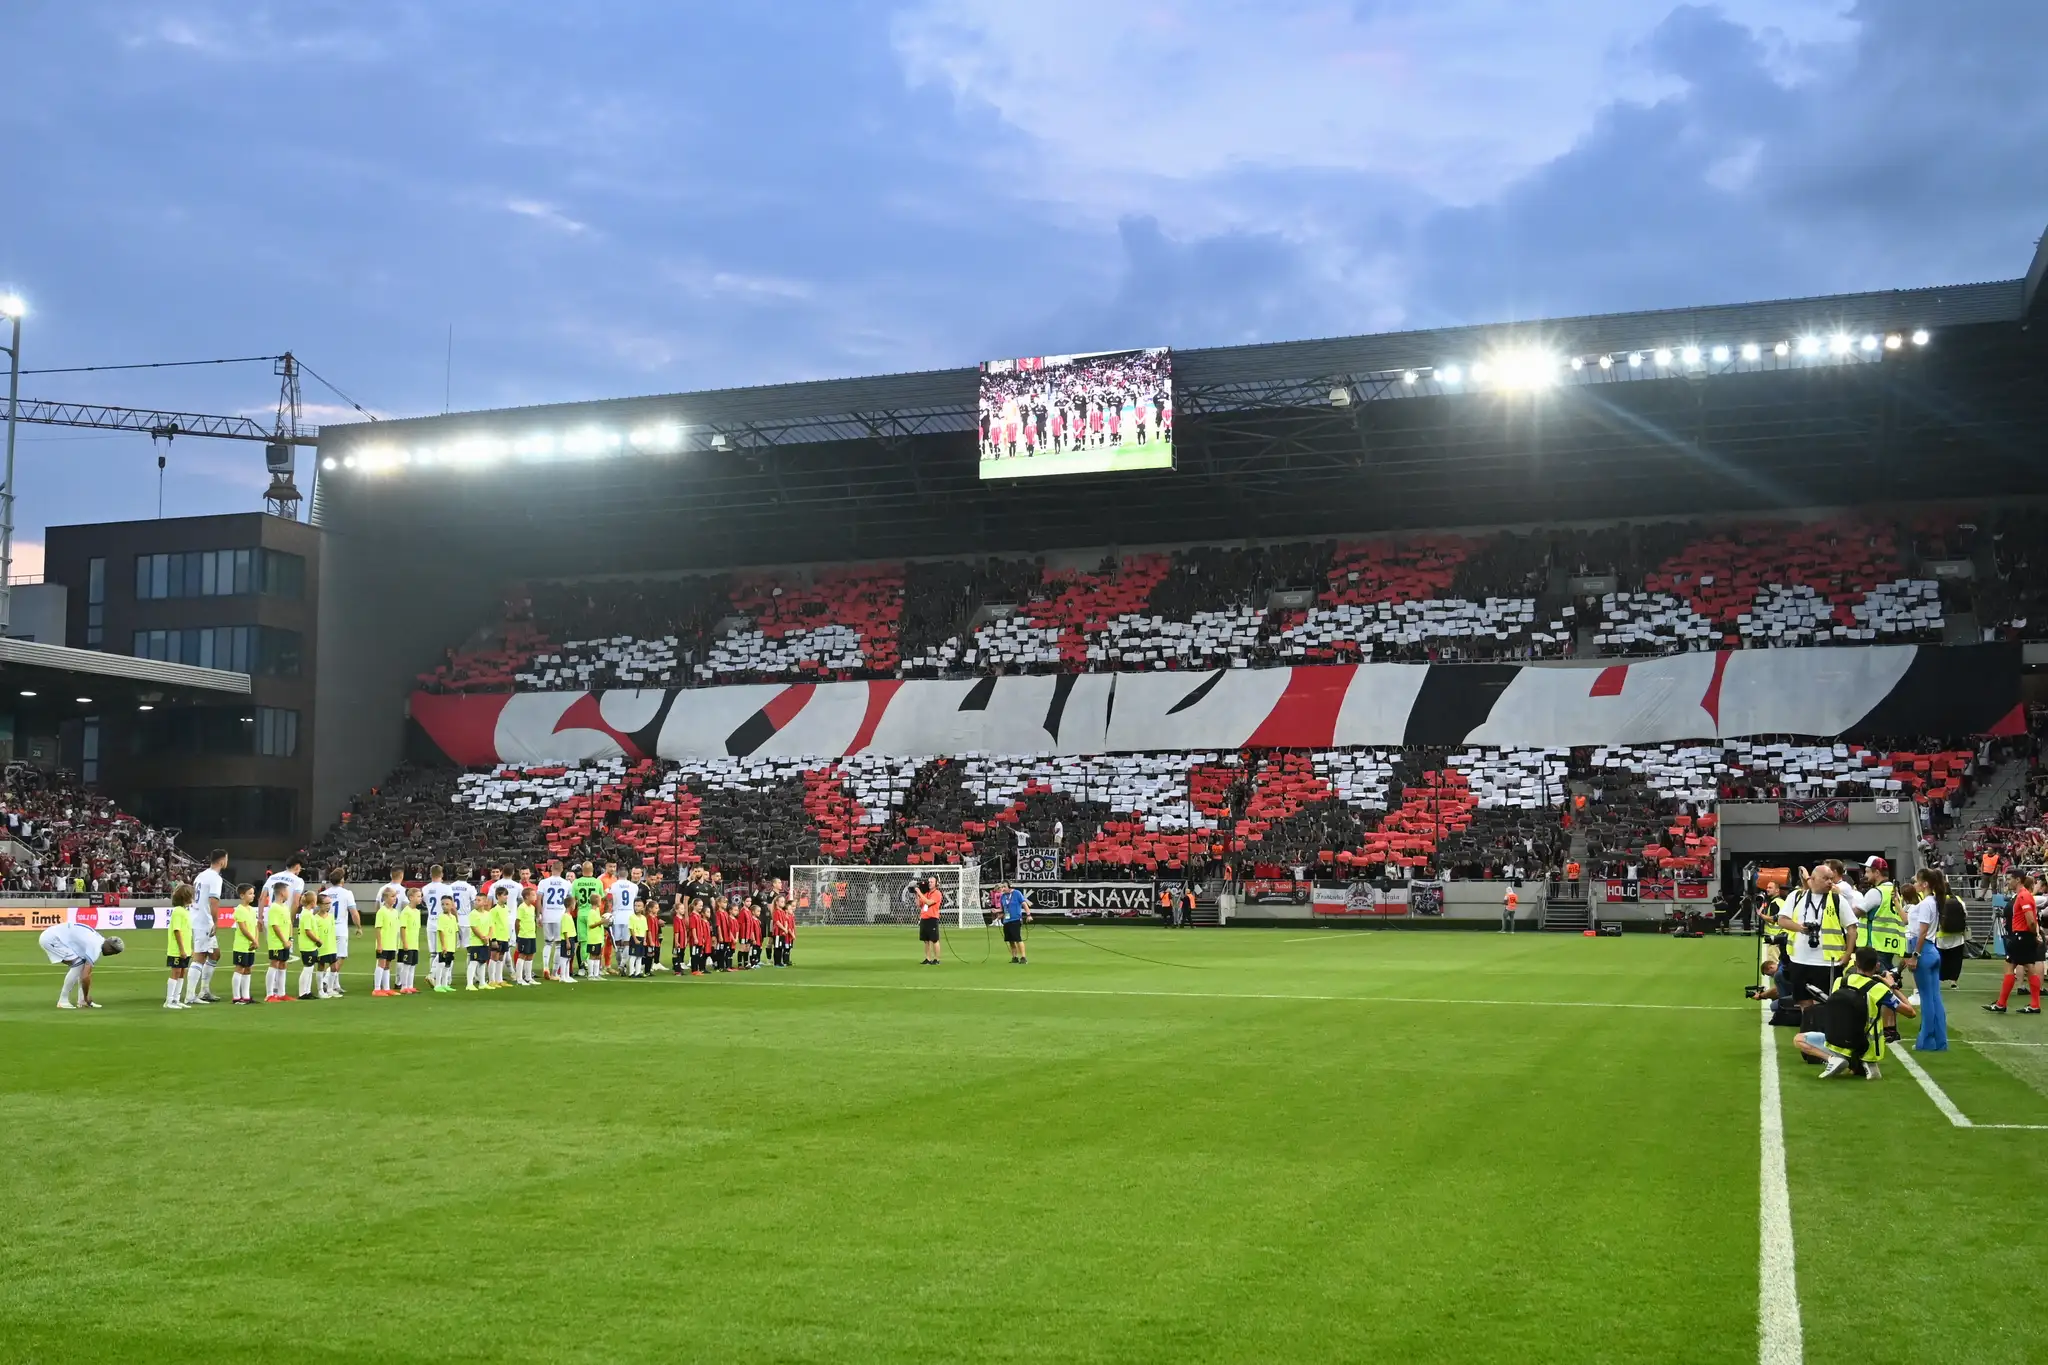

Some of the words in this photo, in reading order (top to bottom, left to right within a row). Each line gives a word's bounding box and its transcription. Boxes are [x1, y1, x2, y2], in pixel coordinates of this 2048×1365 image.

[1019, 848, 1056, 856] SPARTAK
[1019, 871, 1056, 880] TRNAVA
[547, 887, 565, 905] 23
[578, 888, 596, 904] 35
[622, 890, 630, 906] 9
[1059, 888, 1150, 908] TRNAVA
[1607, 883, 1637, 897] HOLÍČ
[430, 896, 437, 916] 2
